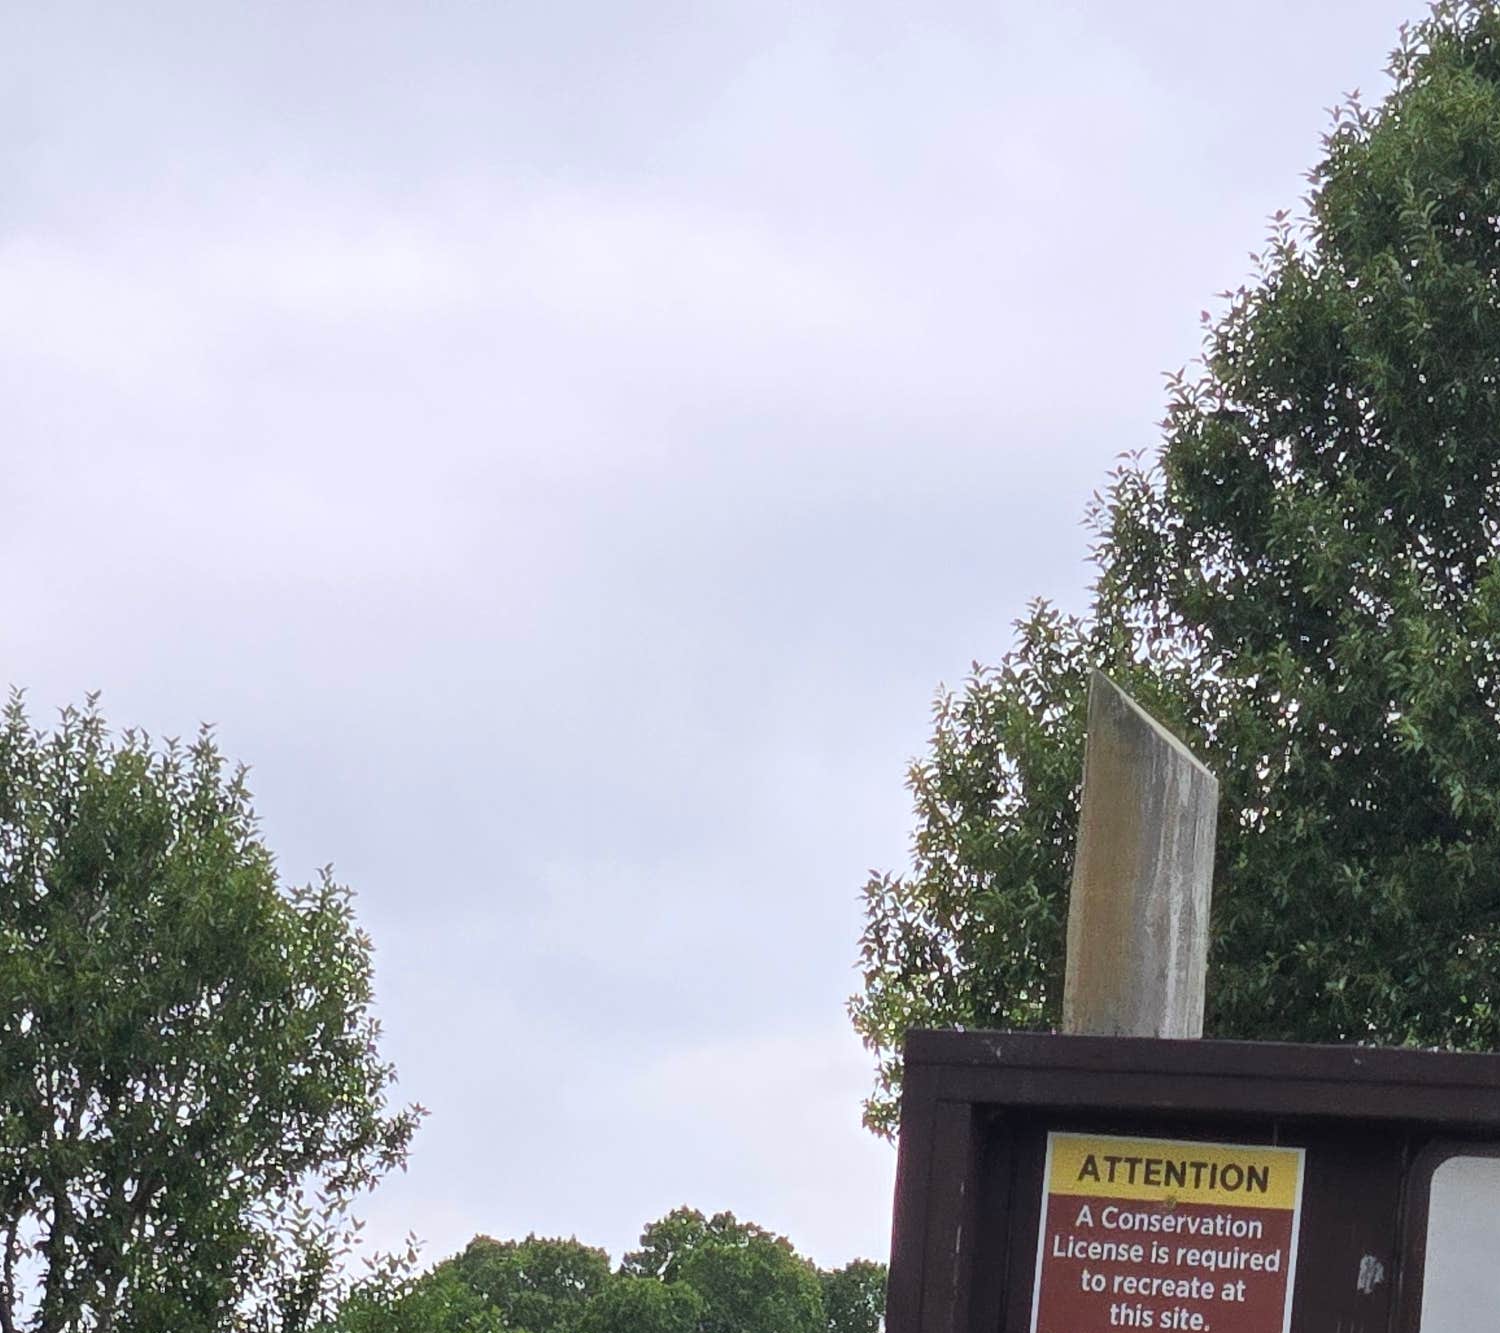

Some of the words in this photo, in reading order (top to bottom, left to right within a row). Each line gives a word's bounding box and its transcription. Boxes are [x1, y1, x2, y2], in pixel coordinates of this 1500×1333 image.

[1077, 1154, 1270, 1193] ATTENTION
[1075, 1205, 1093, 1227] A
[1101, 1206, 1262, 1239] Conservation
[1053, 1235, 1143, 1262] License
[1150, 1241, 1169, 1264] is
[1176, 1247, 1280, 1273] required
[1081, 1269, 1106, 1292] to
[1113, 1274, 1214, 1300] recreate
[1221, 1280, 1246, 1302] at
[1110, 1303, 1153, 1327] this
[1160, 1307, 1210, 1332] site.
